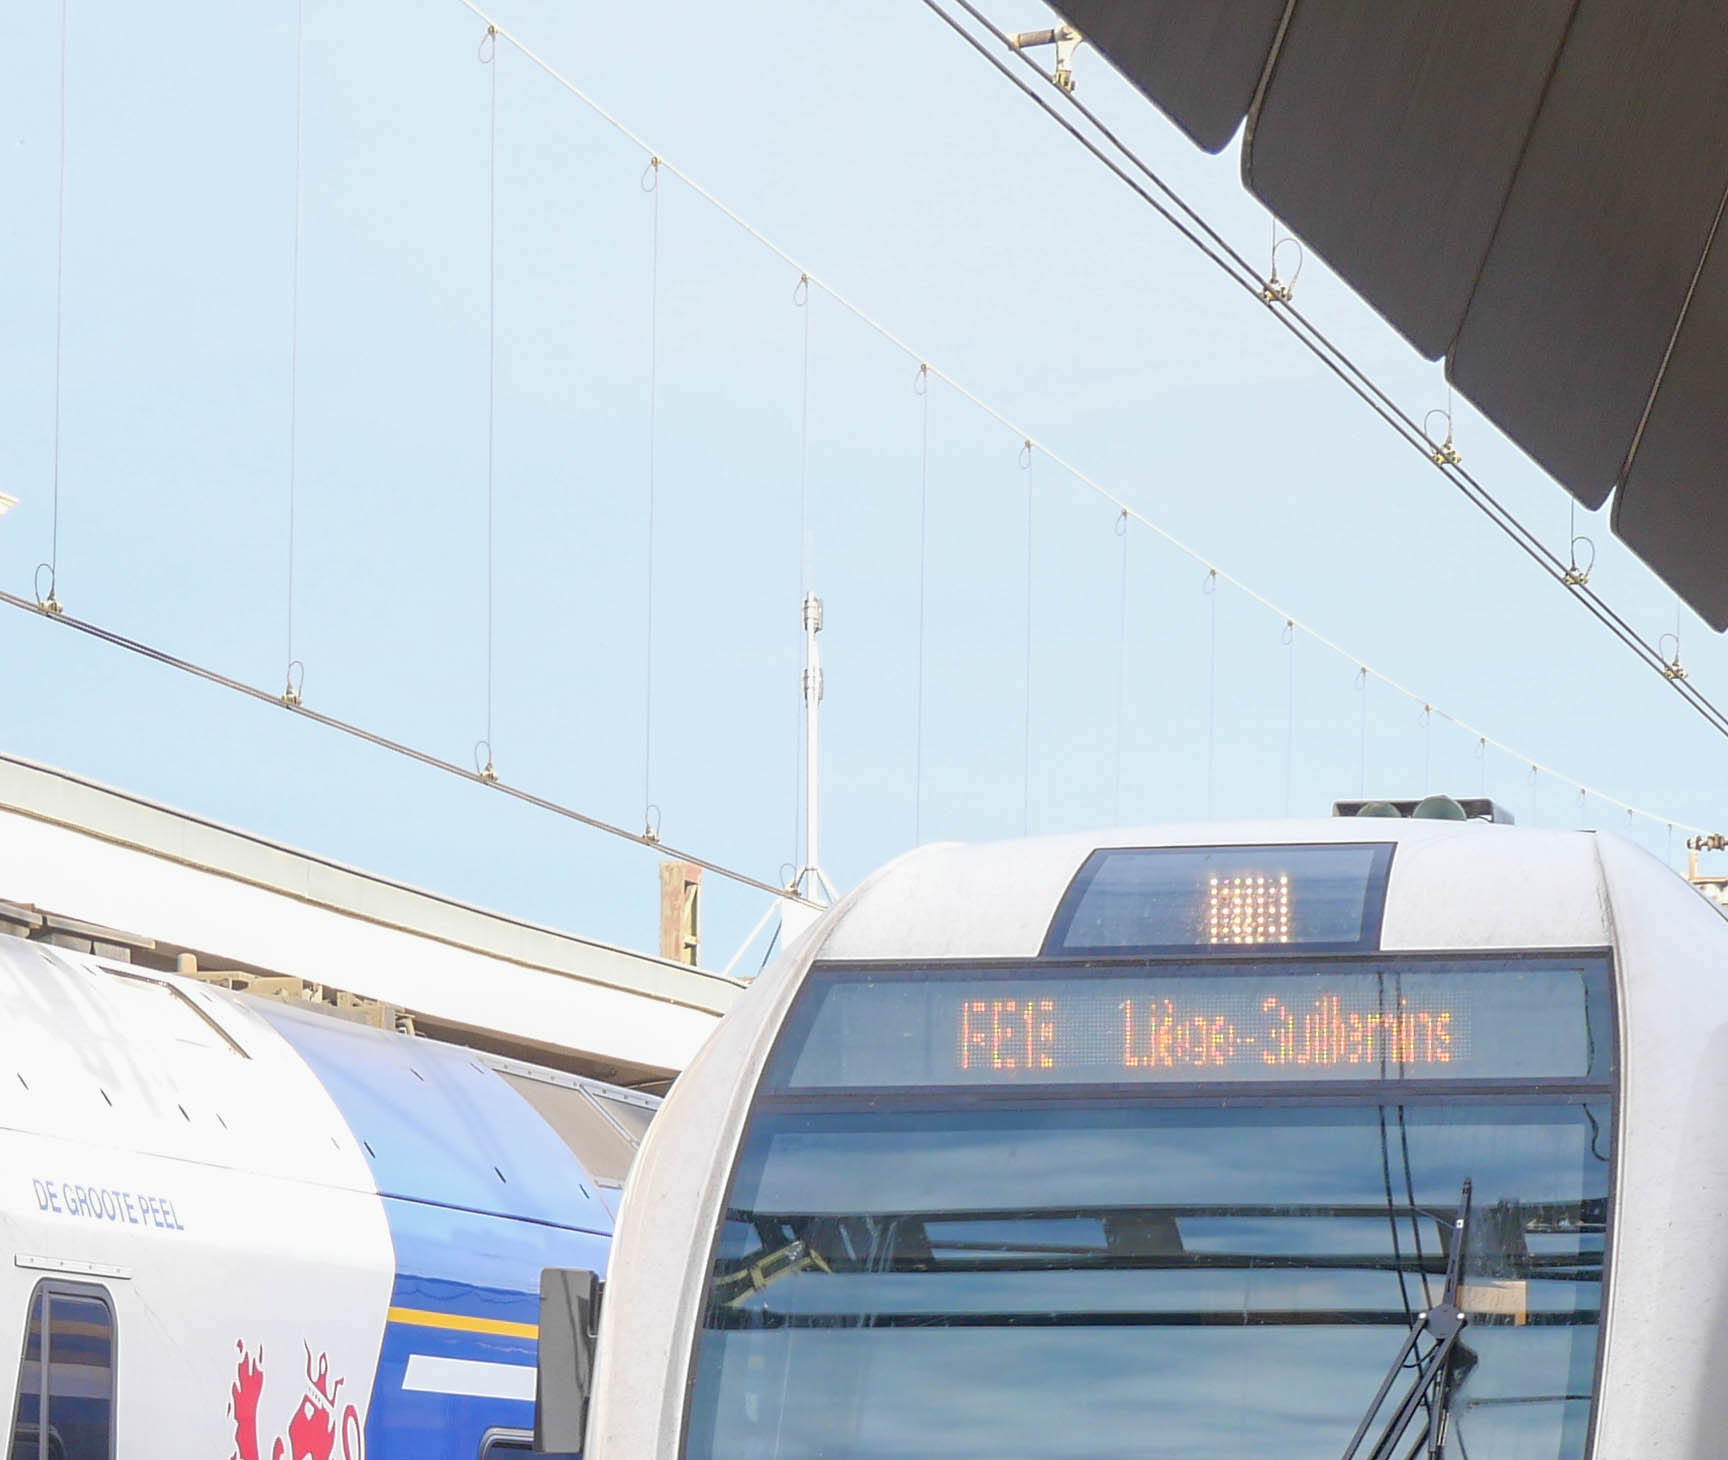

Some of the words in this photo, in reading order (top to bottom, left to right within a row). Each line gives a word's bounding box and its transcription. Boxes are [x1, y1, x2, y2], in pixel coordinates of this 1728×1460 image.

[33, 1178, 63, 1213] DE
[62, 1182, 139, 1224] GROOTE
[137, 1194, 185, 1231] PEEL
